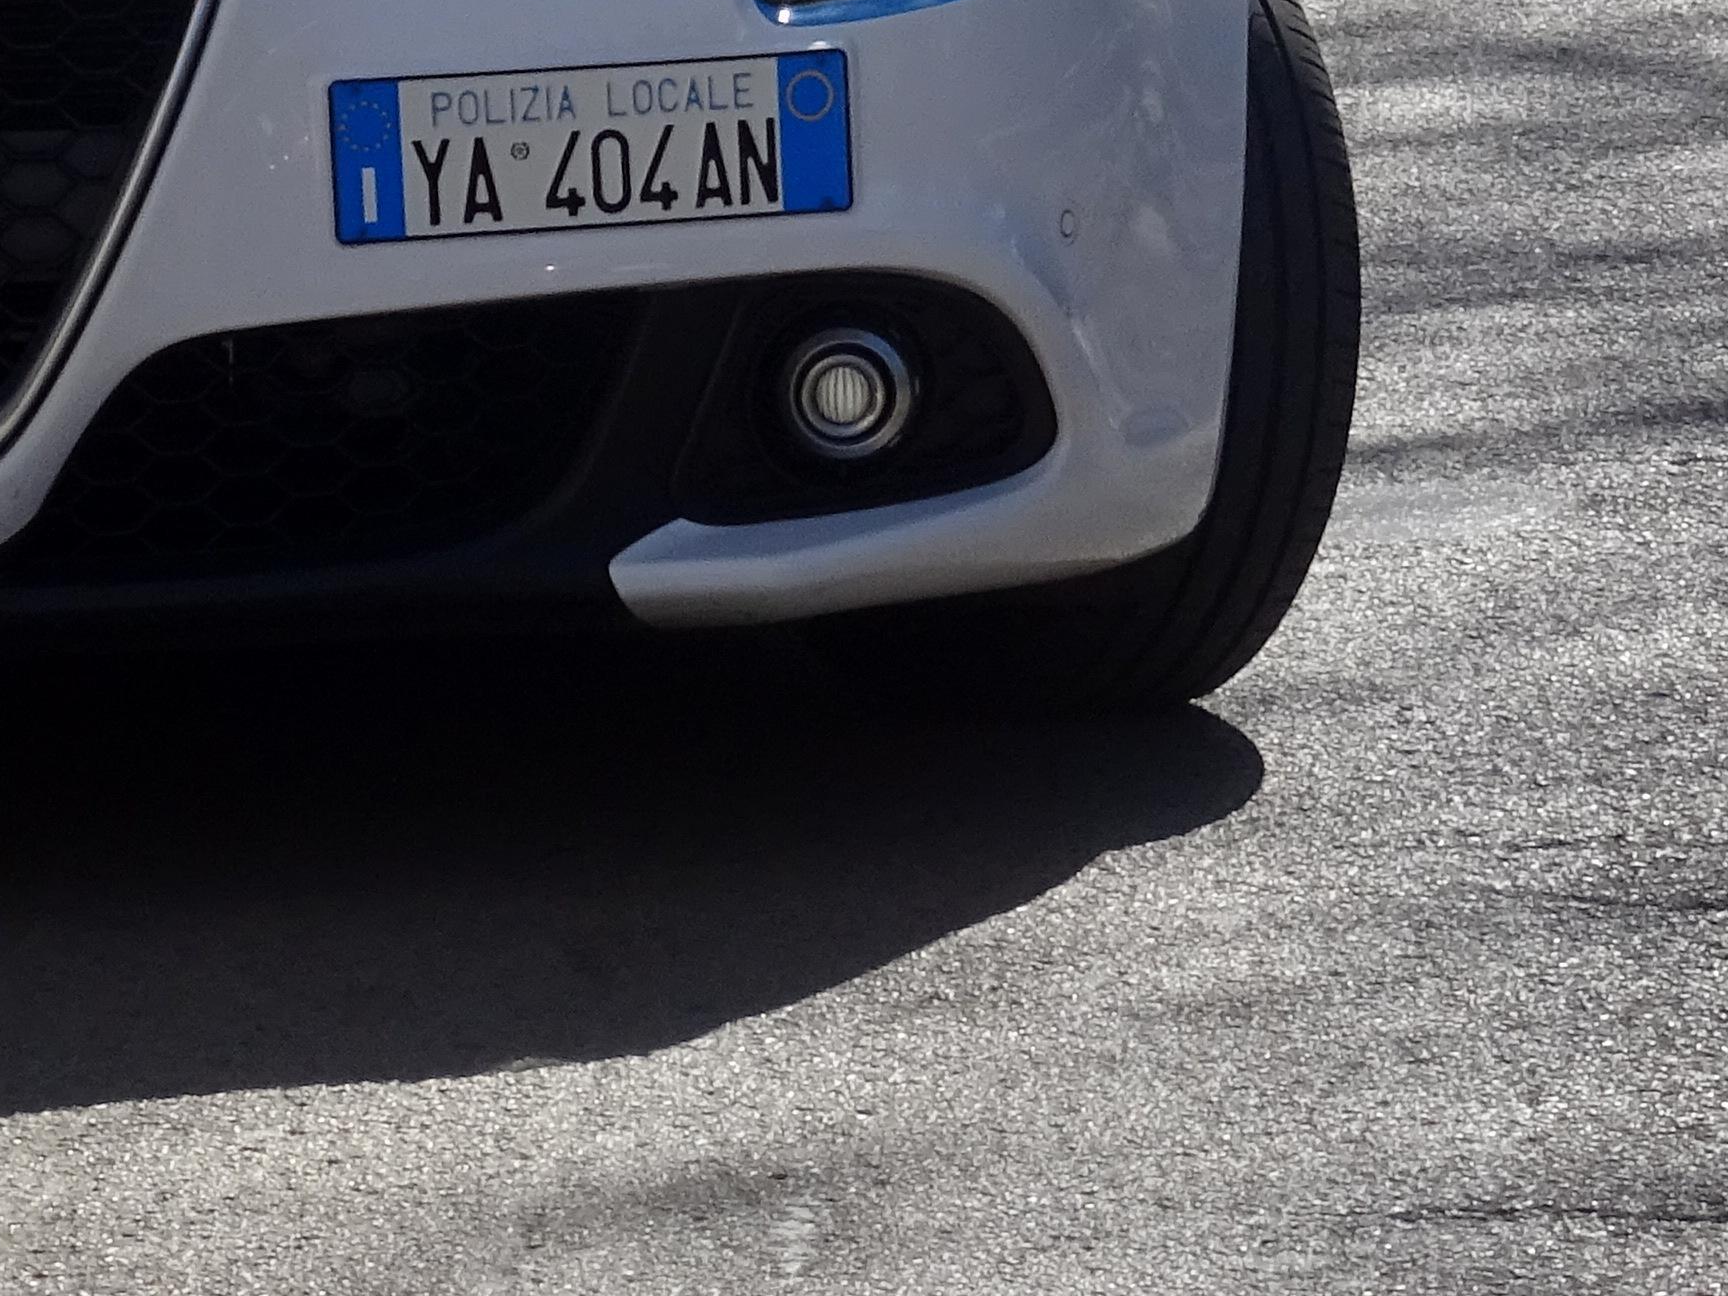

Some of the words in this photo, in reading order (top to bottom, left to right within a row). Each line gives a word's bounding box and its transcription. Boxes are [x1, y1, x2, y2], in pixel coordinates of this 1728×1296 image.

[430, 84, 577, 129] POLIZIA
[605, 72, 755, 119] LOCALE
[411, 136, 504, 226] YA
